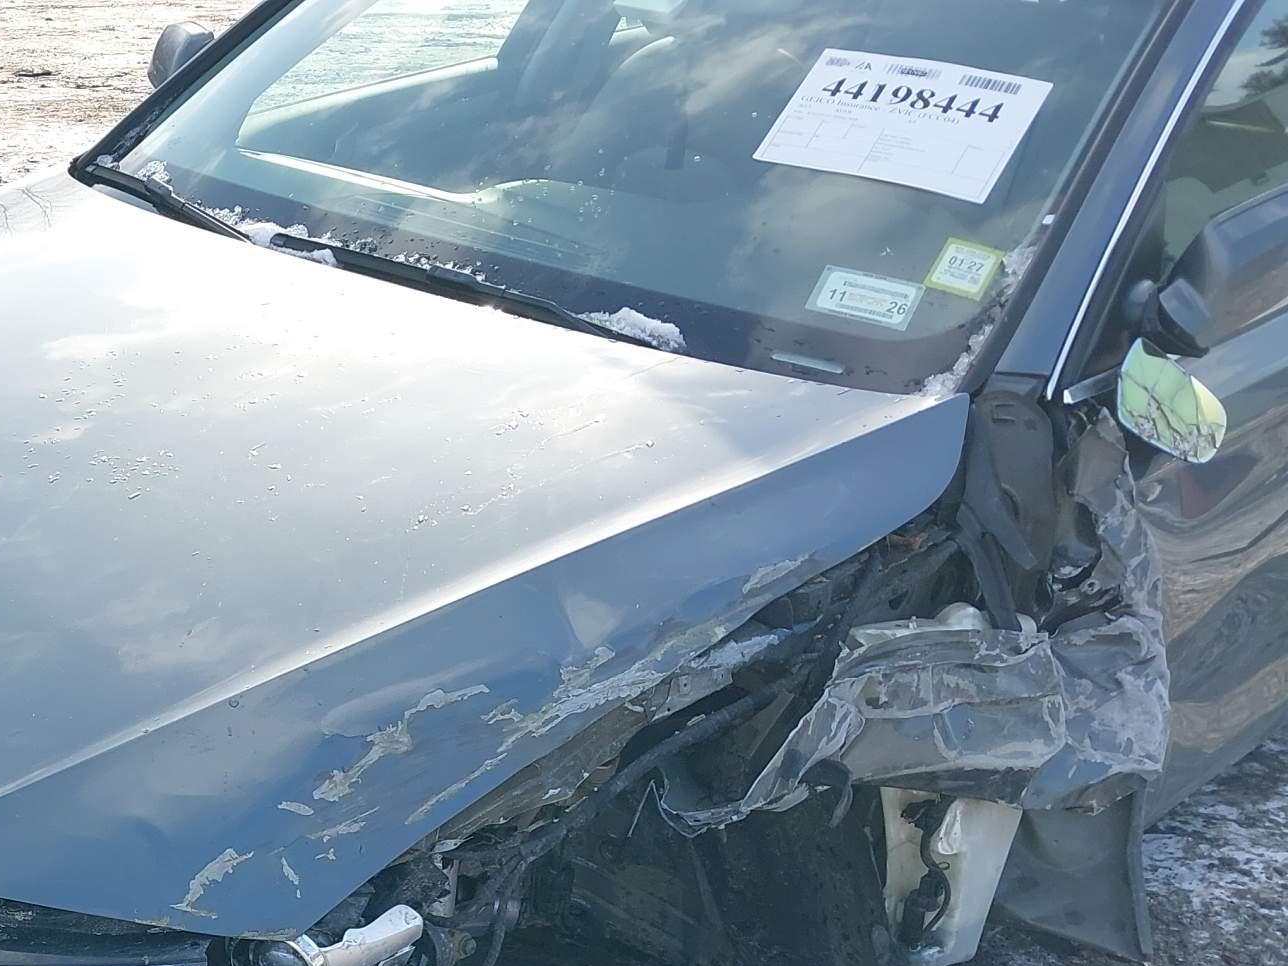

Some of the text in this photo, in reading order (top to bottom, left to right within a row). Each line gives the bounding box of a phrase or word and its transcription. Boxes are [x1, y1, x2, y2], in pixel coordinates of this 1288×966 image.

[822, 77, 1004, 123] 44198444
[829, 288, 847, 302] 11
[886, 301, 908, 315] 26
